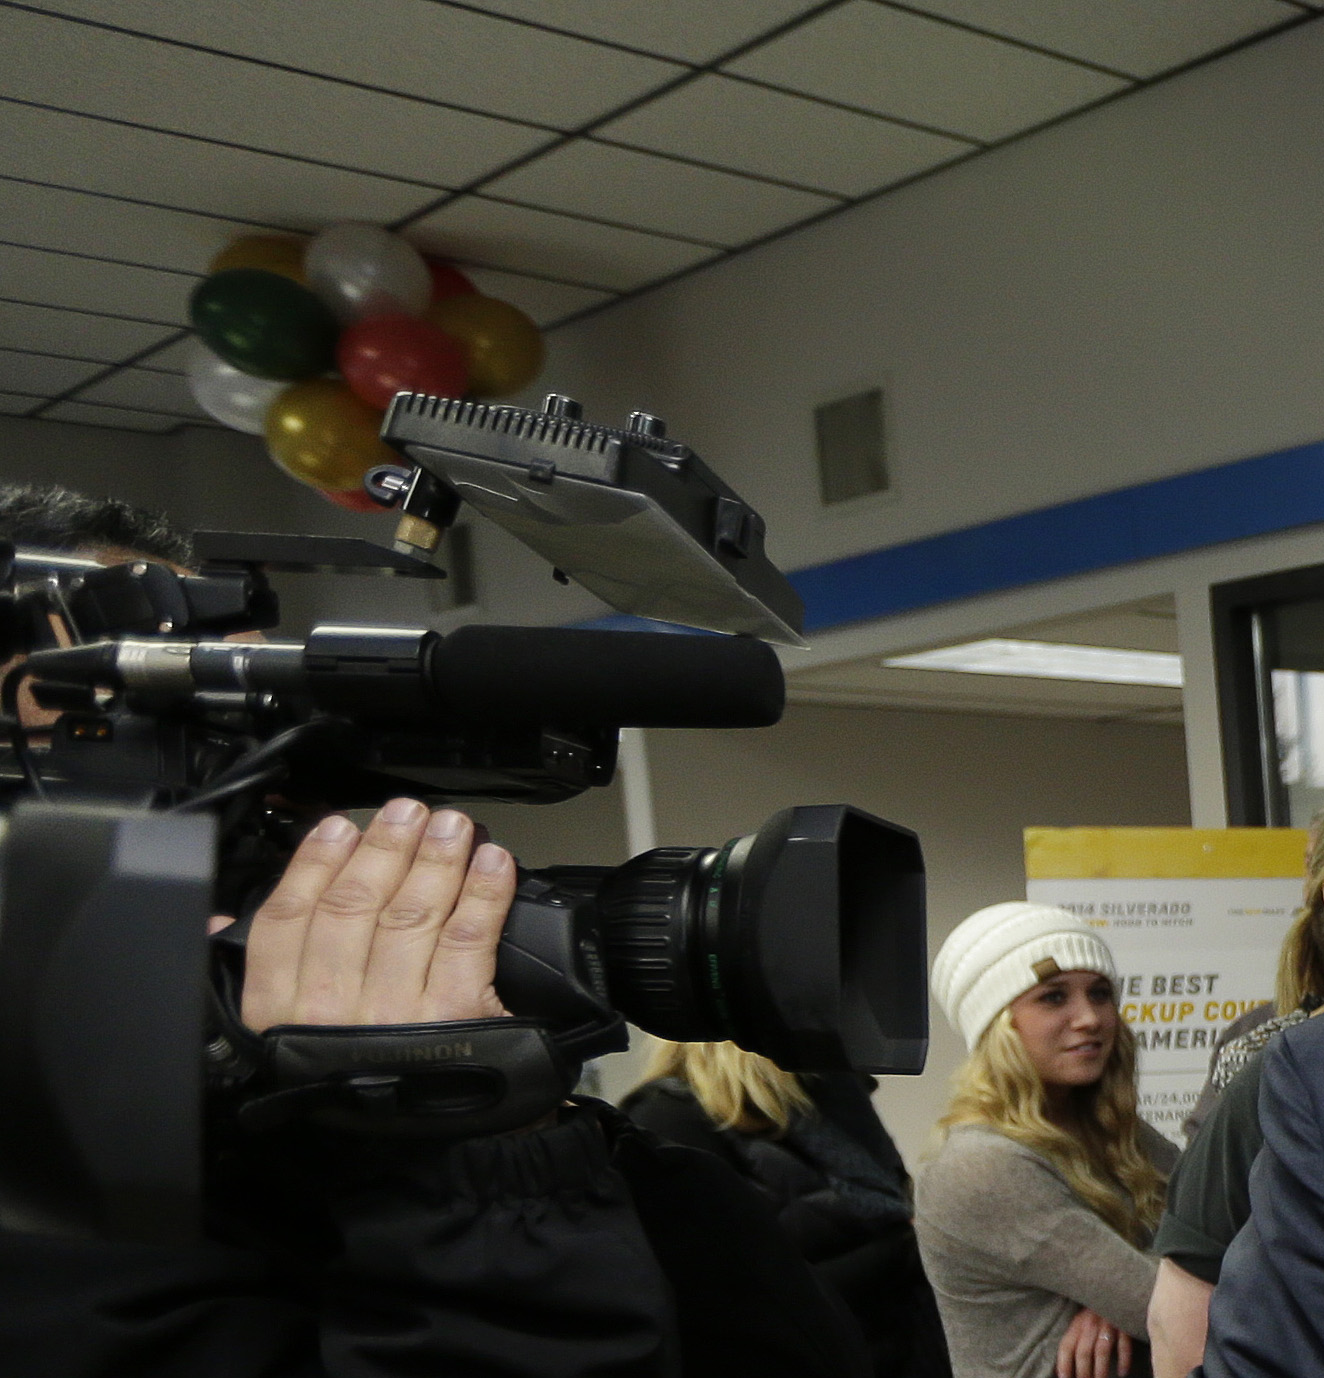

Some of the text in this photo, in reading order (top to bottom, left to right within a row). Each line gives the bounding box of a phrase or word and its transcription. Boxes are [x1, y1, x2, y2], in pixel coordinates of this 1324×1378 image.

[1100, 902, 1190, 915] SILVERADO
[1150, 974, 1219, 996] BEST
[1121, 1002, 1195, 1023] CKUP
[1135, 1027, 1218, 1050] AMERI
